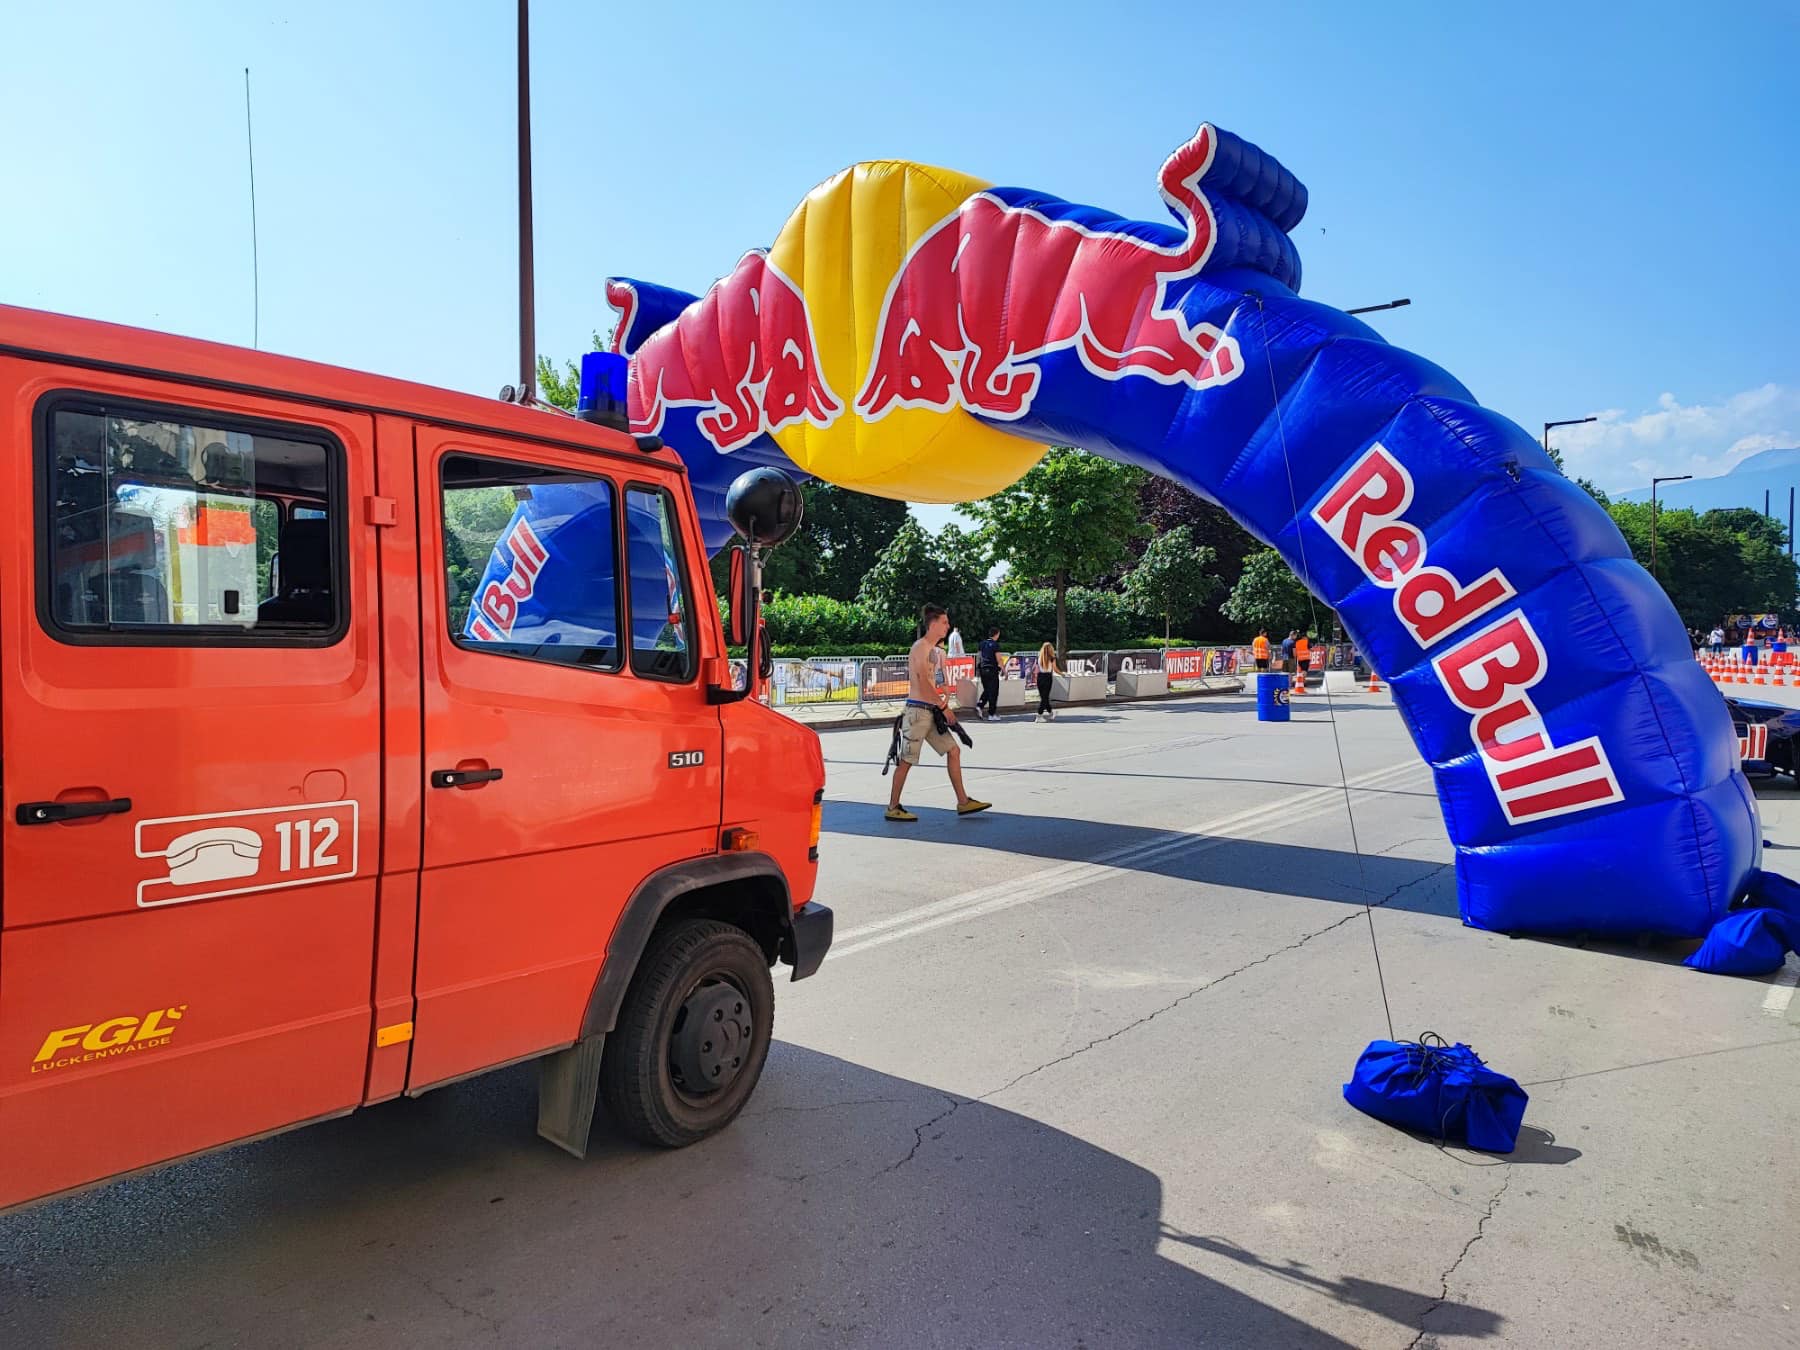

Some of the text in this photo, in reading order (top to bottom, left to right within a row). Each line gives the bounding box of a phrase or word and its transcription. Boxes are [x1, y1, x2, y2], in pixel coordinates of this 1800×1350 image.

[482, 515, 549, 638] Bull
[1311, 442, 1624, 825] Red Bull
[1166, 656, 1201, 674] WINBET
[671, 751, 704, 767] 510
[275, 817, 339, 872] 112
[31, 1036, 171, 1073] LUCKENWALDE
